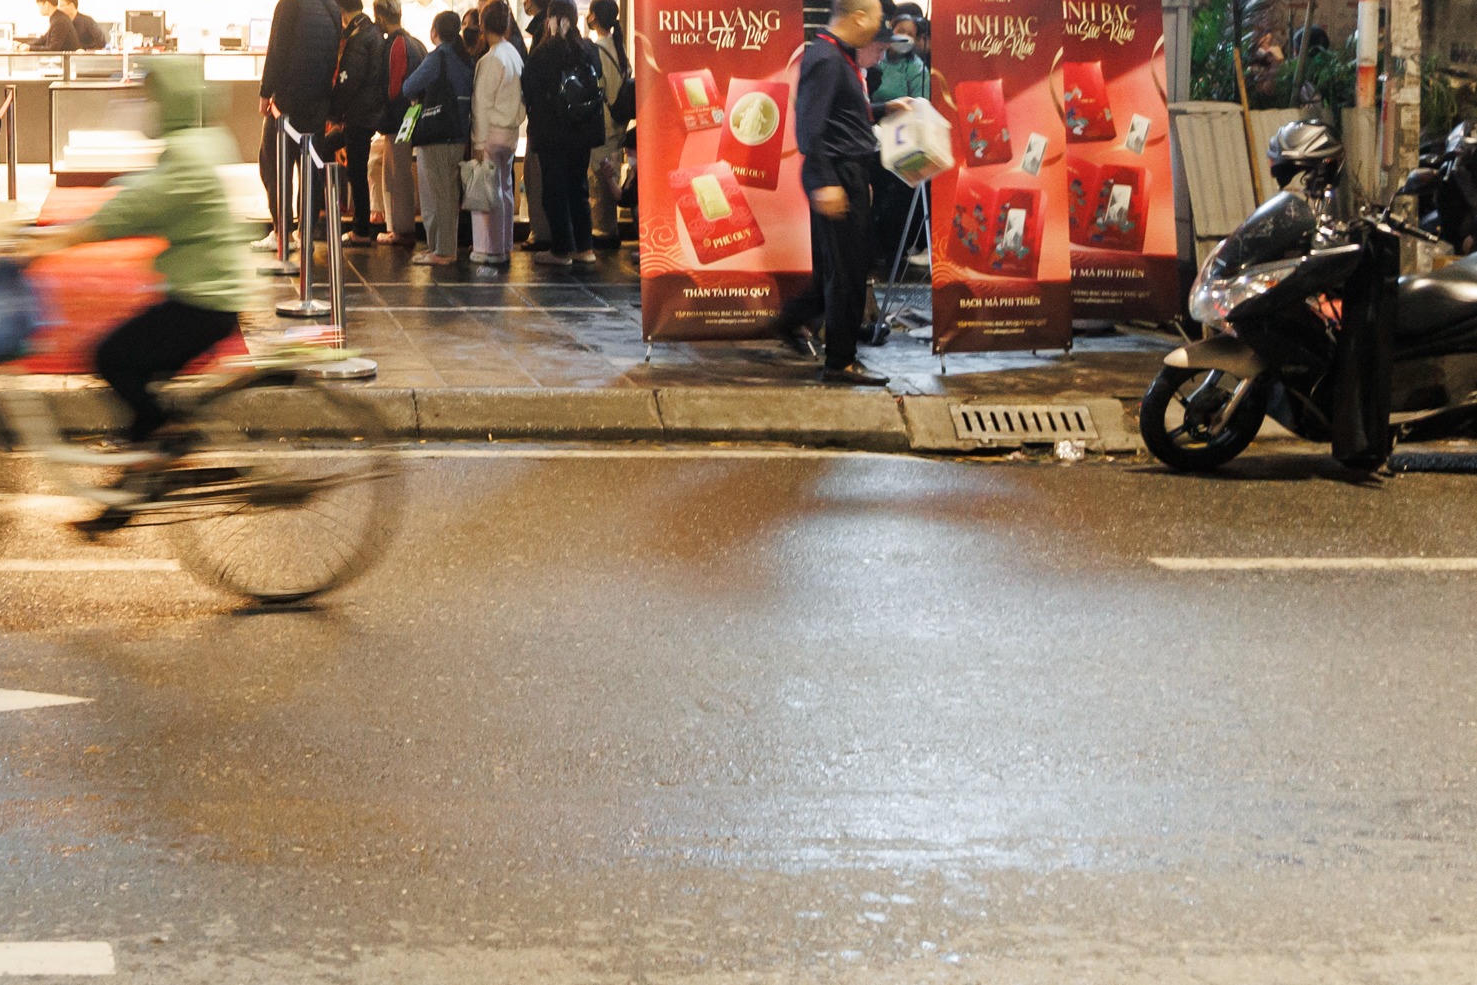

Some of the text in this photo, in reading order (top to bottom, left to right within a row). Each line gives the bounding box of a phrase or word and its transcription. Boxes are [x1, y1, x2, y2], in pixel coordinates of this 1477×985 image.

[658, 6, 781, 32] RINH VÀNG
[1062, 0, 1096, 22] INH
[956, 14, 999, 36] RINH
